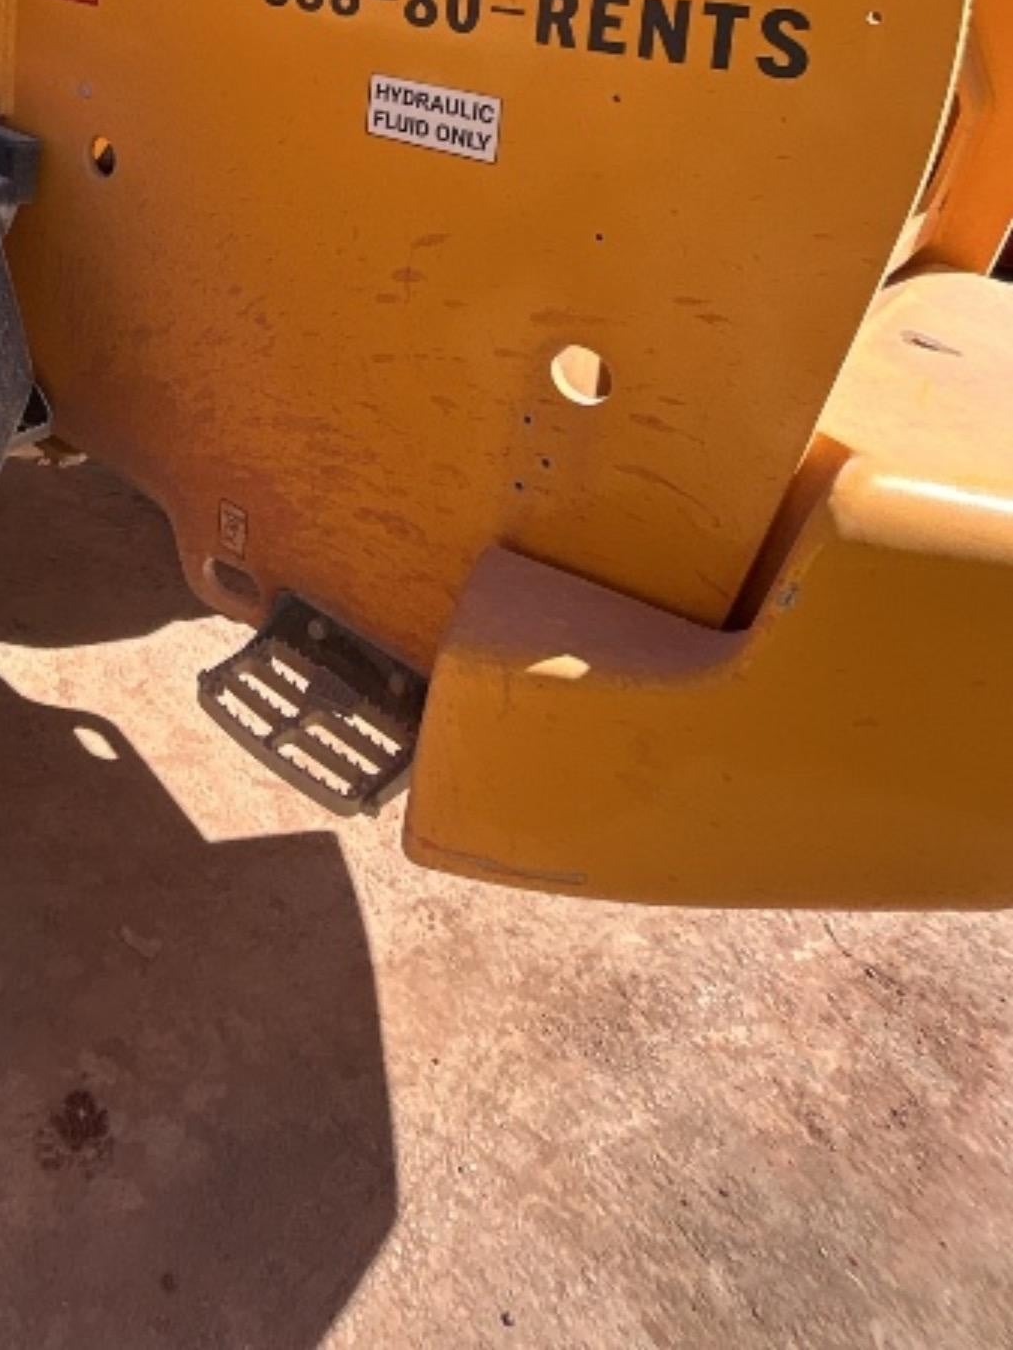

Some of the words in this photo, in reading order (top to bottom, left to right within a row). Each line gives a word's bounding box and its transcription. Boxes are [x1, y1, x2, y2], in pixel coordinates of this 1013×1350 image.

[375, 82, 495, 124] HYDRAULIC
[373, 109, 430, 138] FLUID
[435, 122, 492, 151] ONLY
